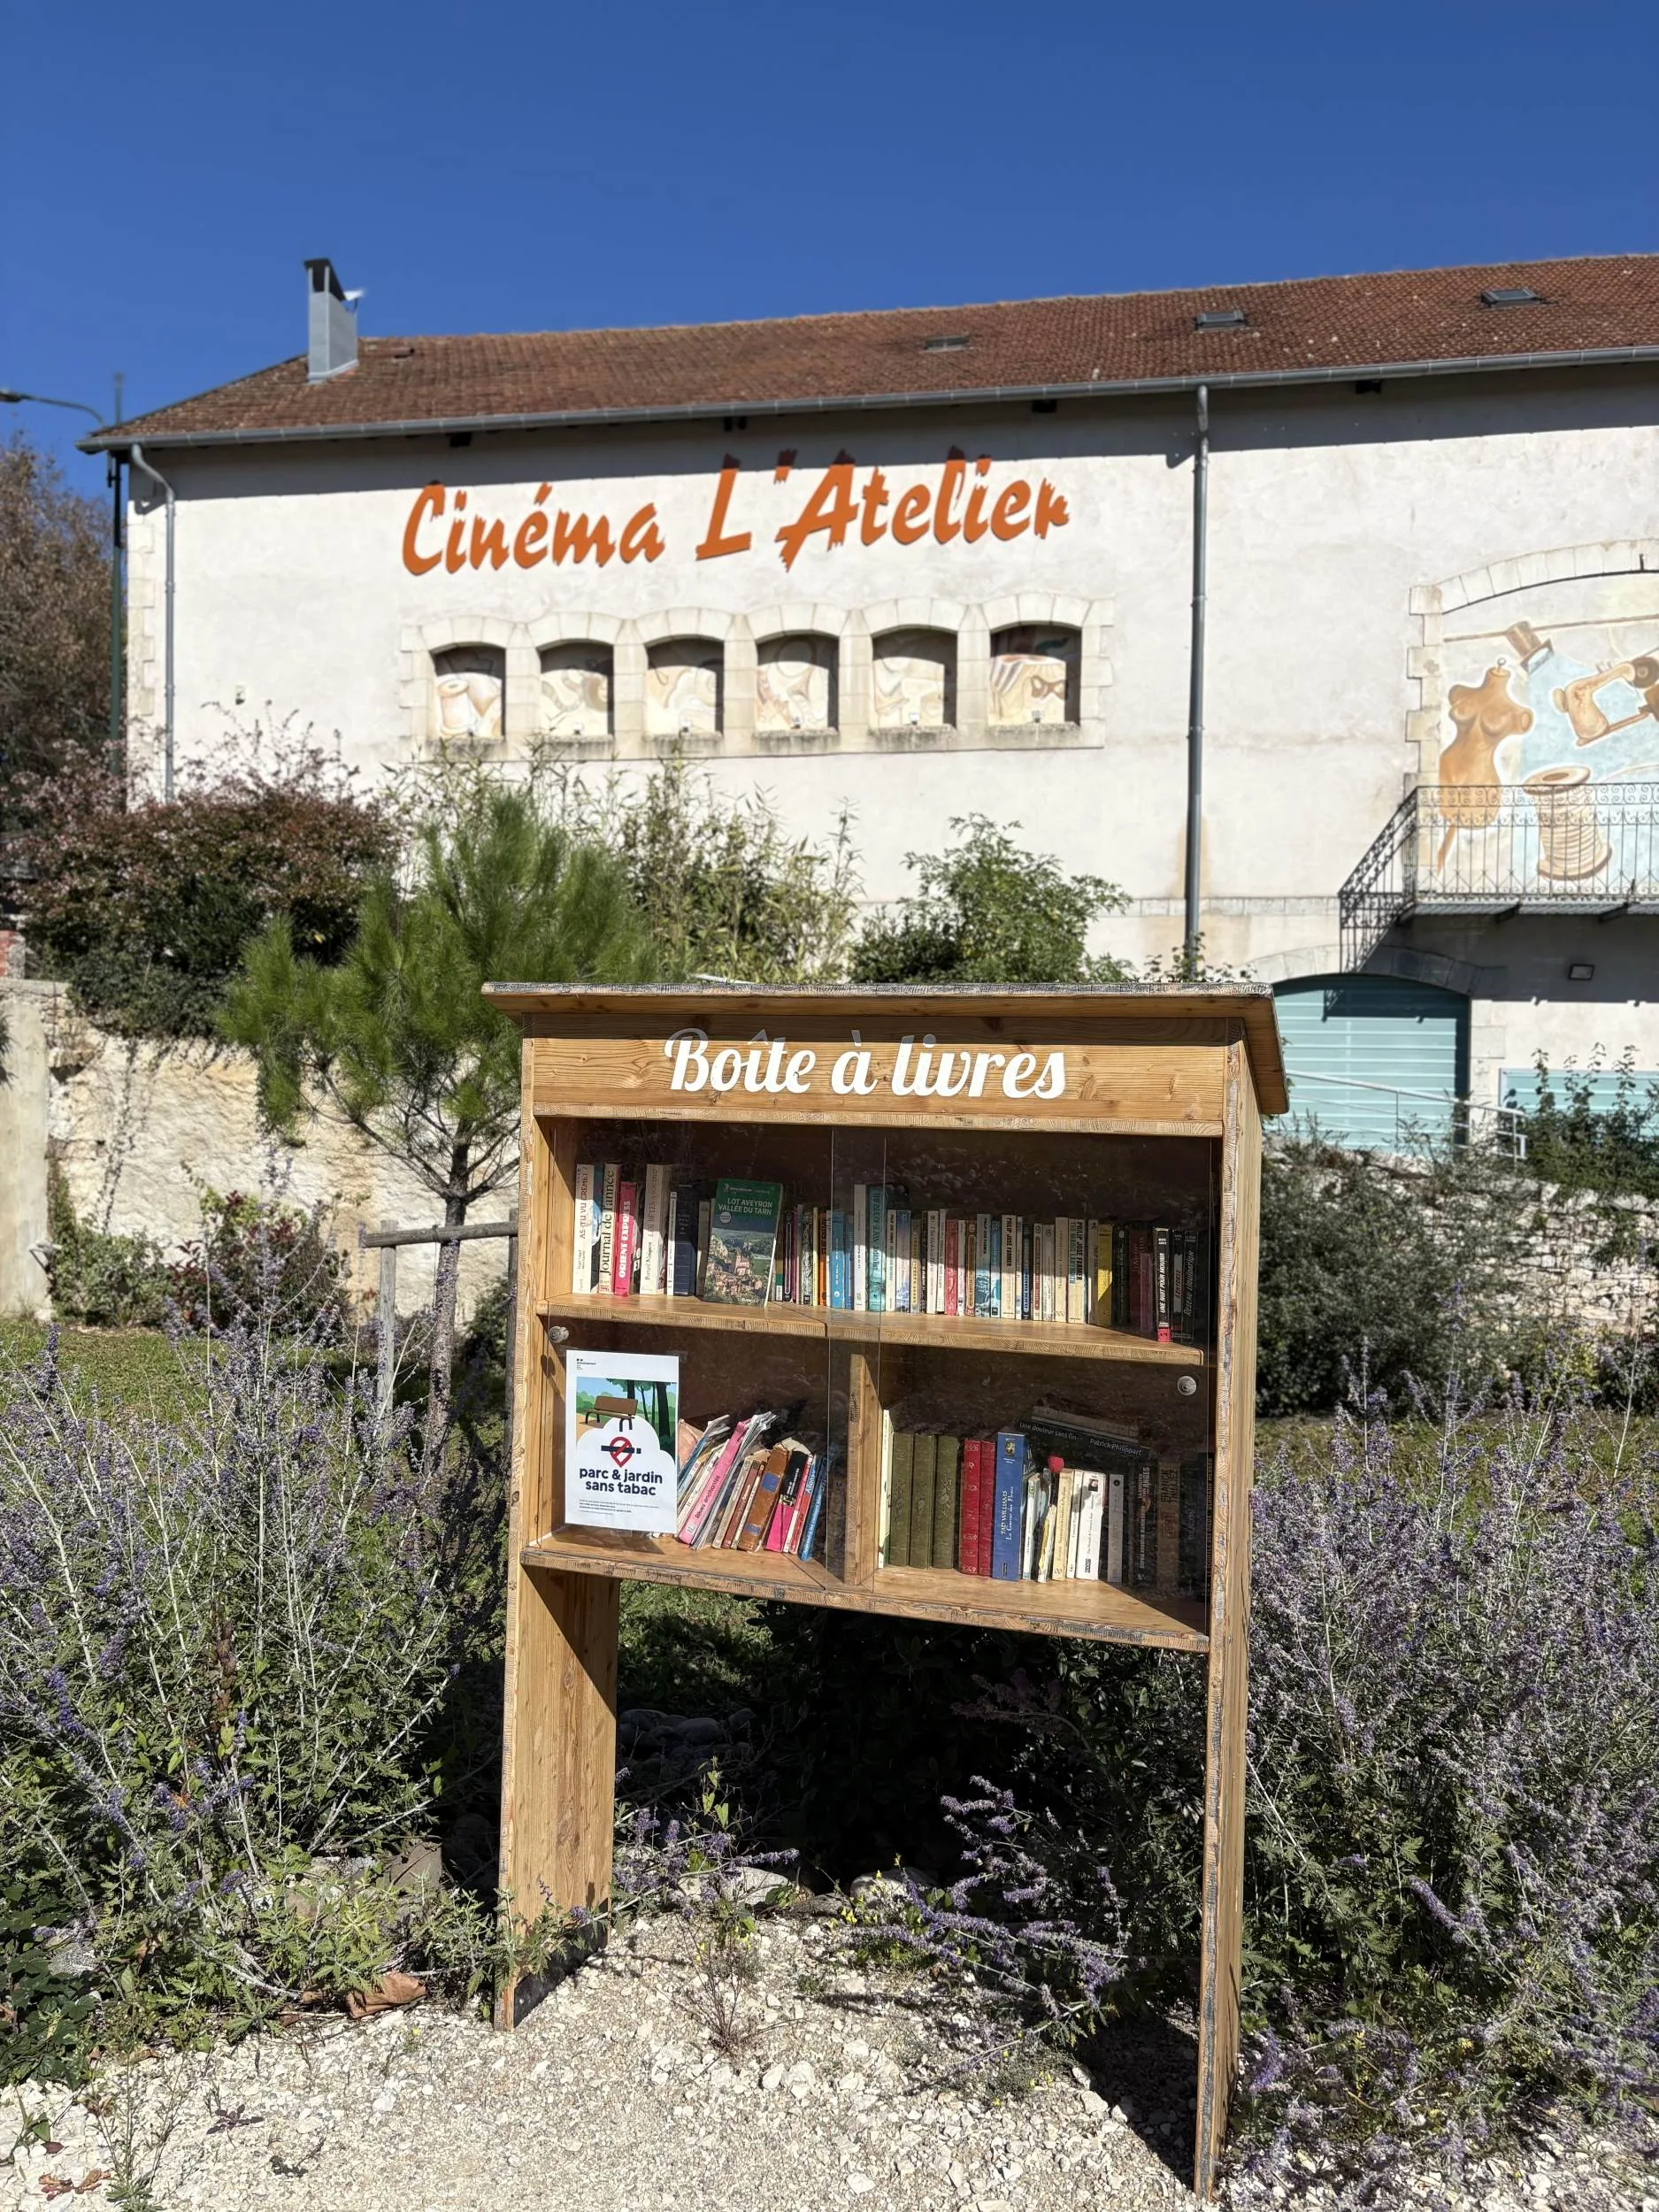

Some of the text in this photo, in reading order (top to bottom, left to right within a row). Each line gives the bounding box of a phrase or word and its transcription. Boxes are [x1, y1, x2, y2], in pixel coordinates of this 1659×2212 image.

[402, 446, 1070, 576] Cinéma L'Atelier
[664, 1027, 1066, 1099] Boîte à livres
[741, 1199, 773, 1209] AVEYRON
[603, 1214, 612, 1230] de
[600, 1233, 612, 1276] Journal
[1032, 1424, 1055, 1435] douleur
[1090, 1438, 1110, 1448] Patrick
[580, 1467, 663, 1484] parc & jardin
[585, 1479, 657, 1496] sans tabac
